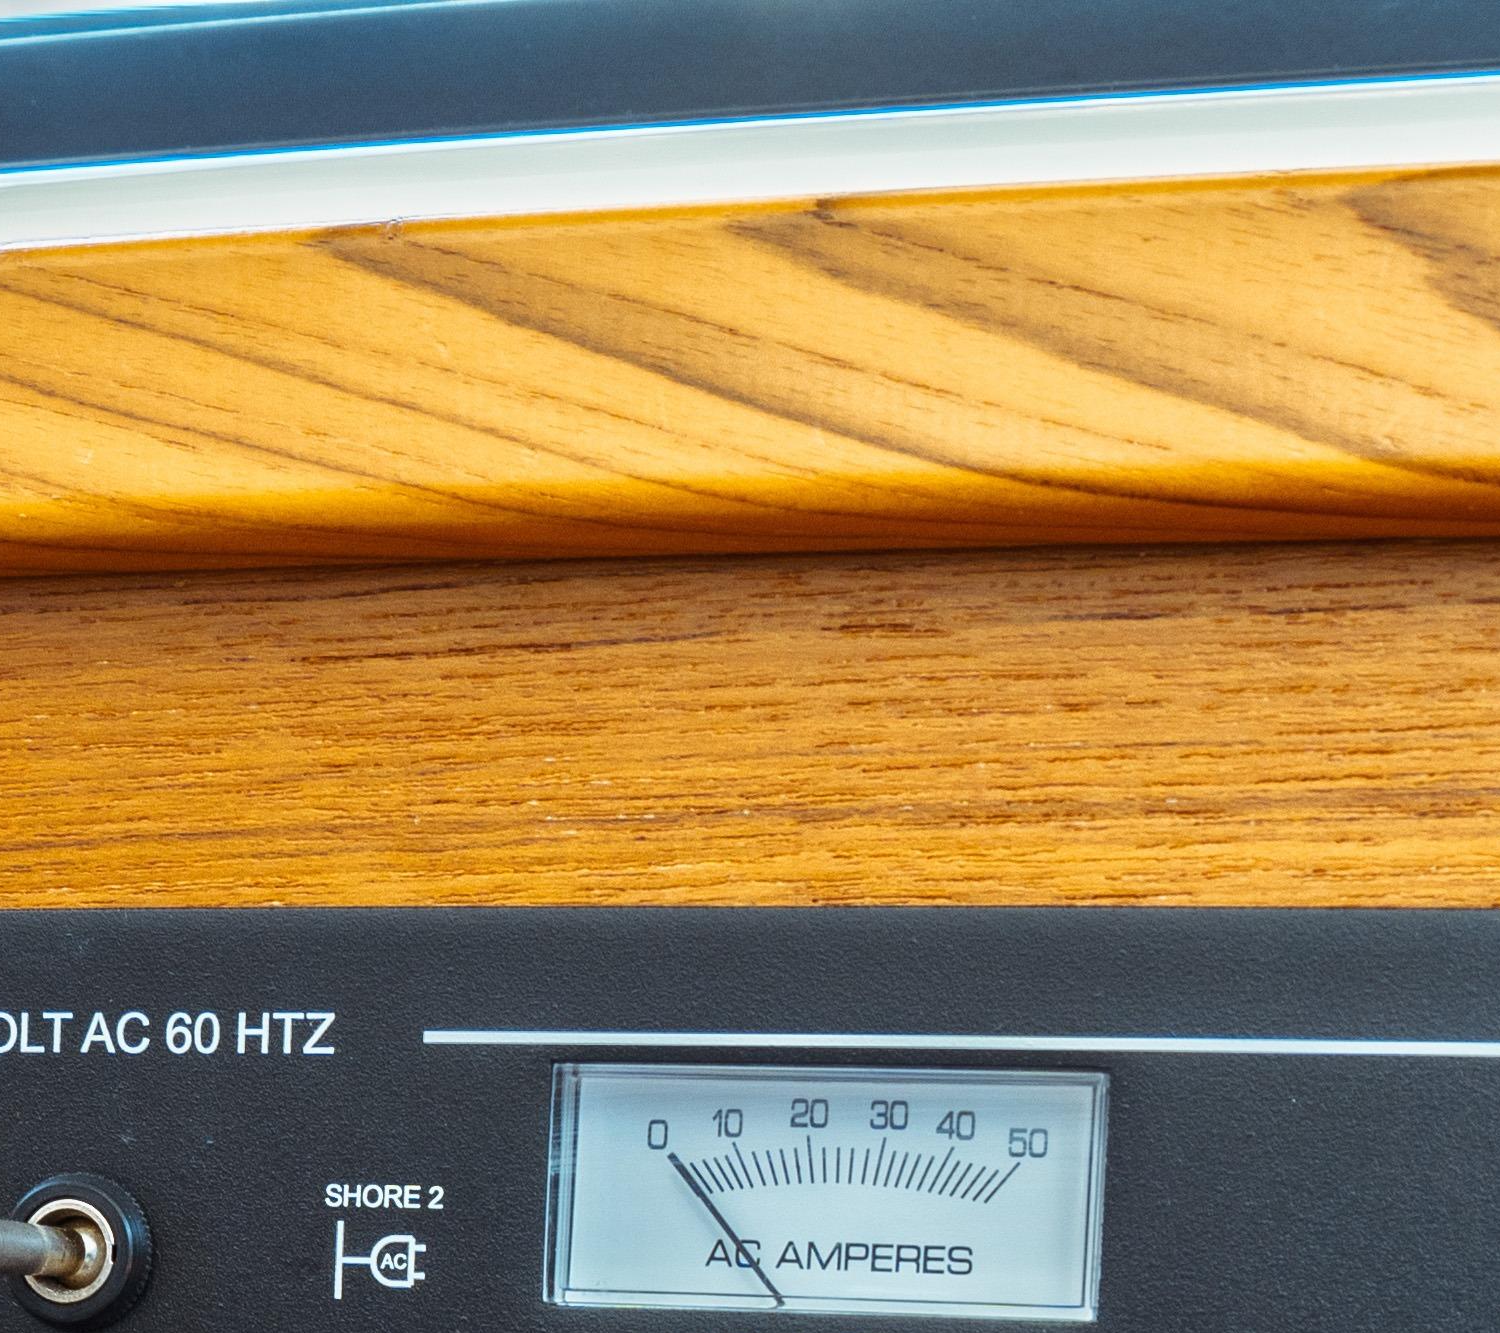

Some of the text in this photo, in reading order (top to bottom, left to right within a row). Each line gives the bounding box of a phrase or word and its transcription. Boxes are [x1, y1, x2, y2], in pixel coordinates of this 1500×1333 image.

[80, 1011, 151, 1054] AC
[165, 1011, 221, 1055] 60
[236, 1011, 336, 1055] HTZ
[712, 1108, 744, 1138] 10
[789, 1097, 830, 1129] 20
[869, 1099, 909, 1131] 30
[935, 1109, 977, 1141] 40
[647, 1118, 669, 1150] 0
[1008, 1127, 1049, 1159] 50
[324, 1183, 445, 1210] SHORE 2
[381, 1252, 407, 1270] AC
[705, 1240, 973, 1275] AC AMPERES
